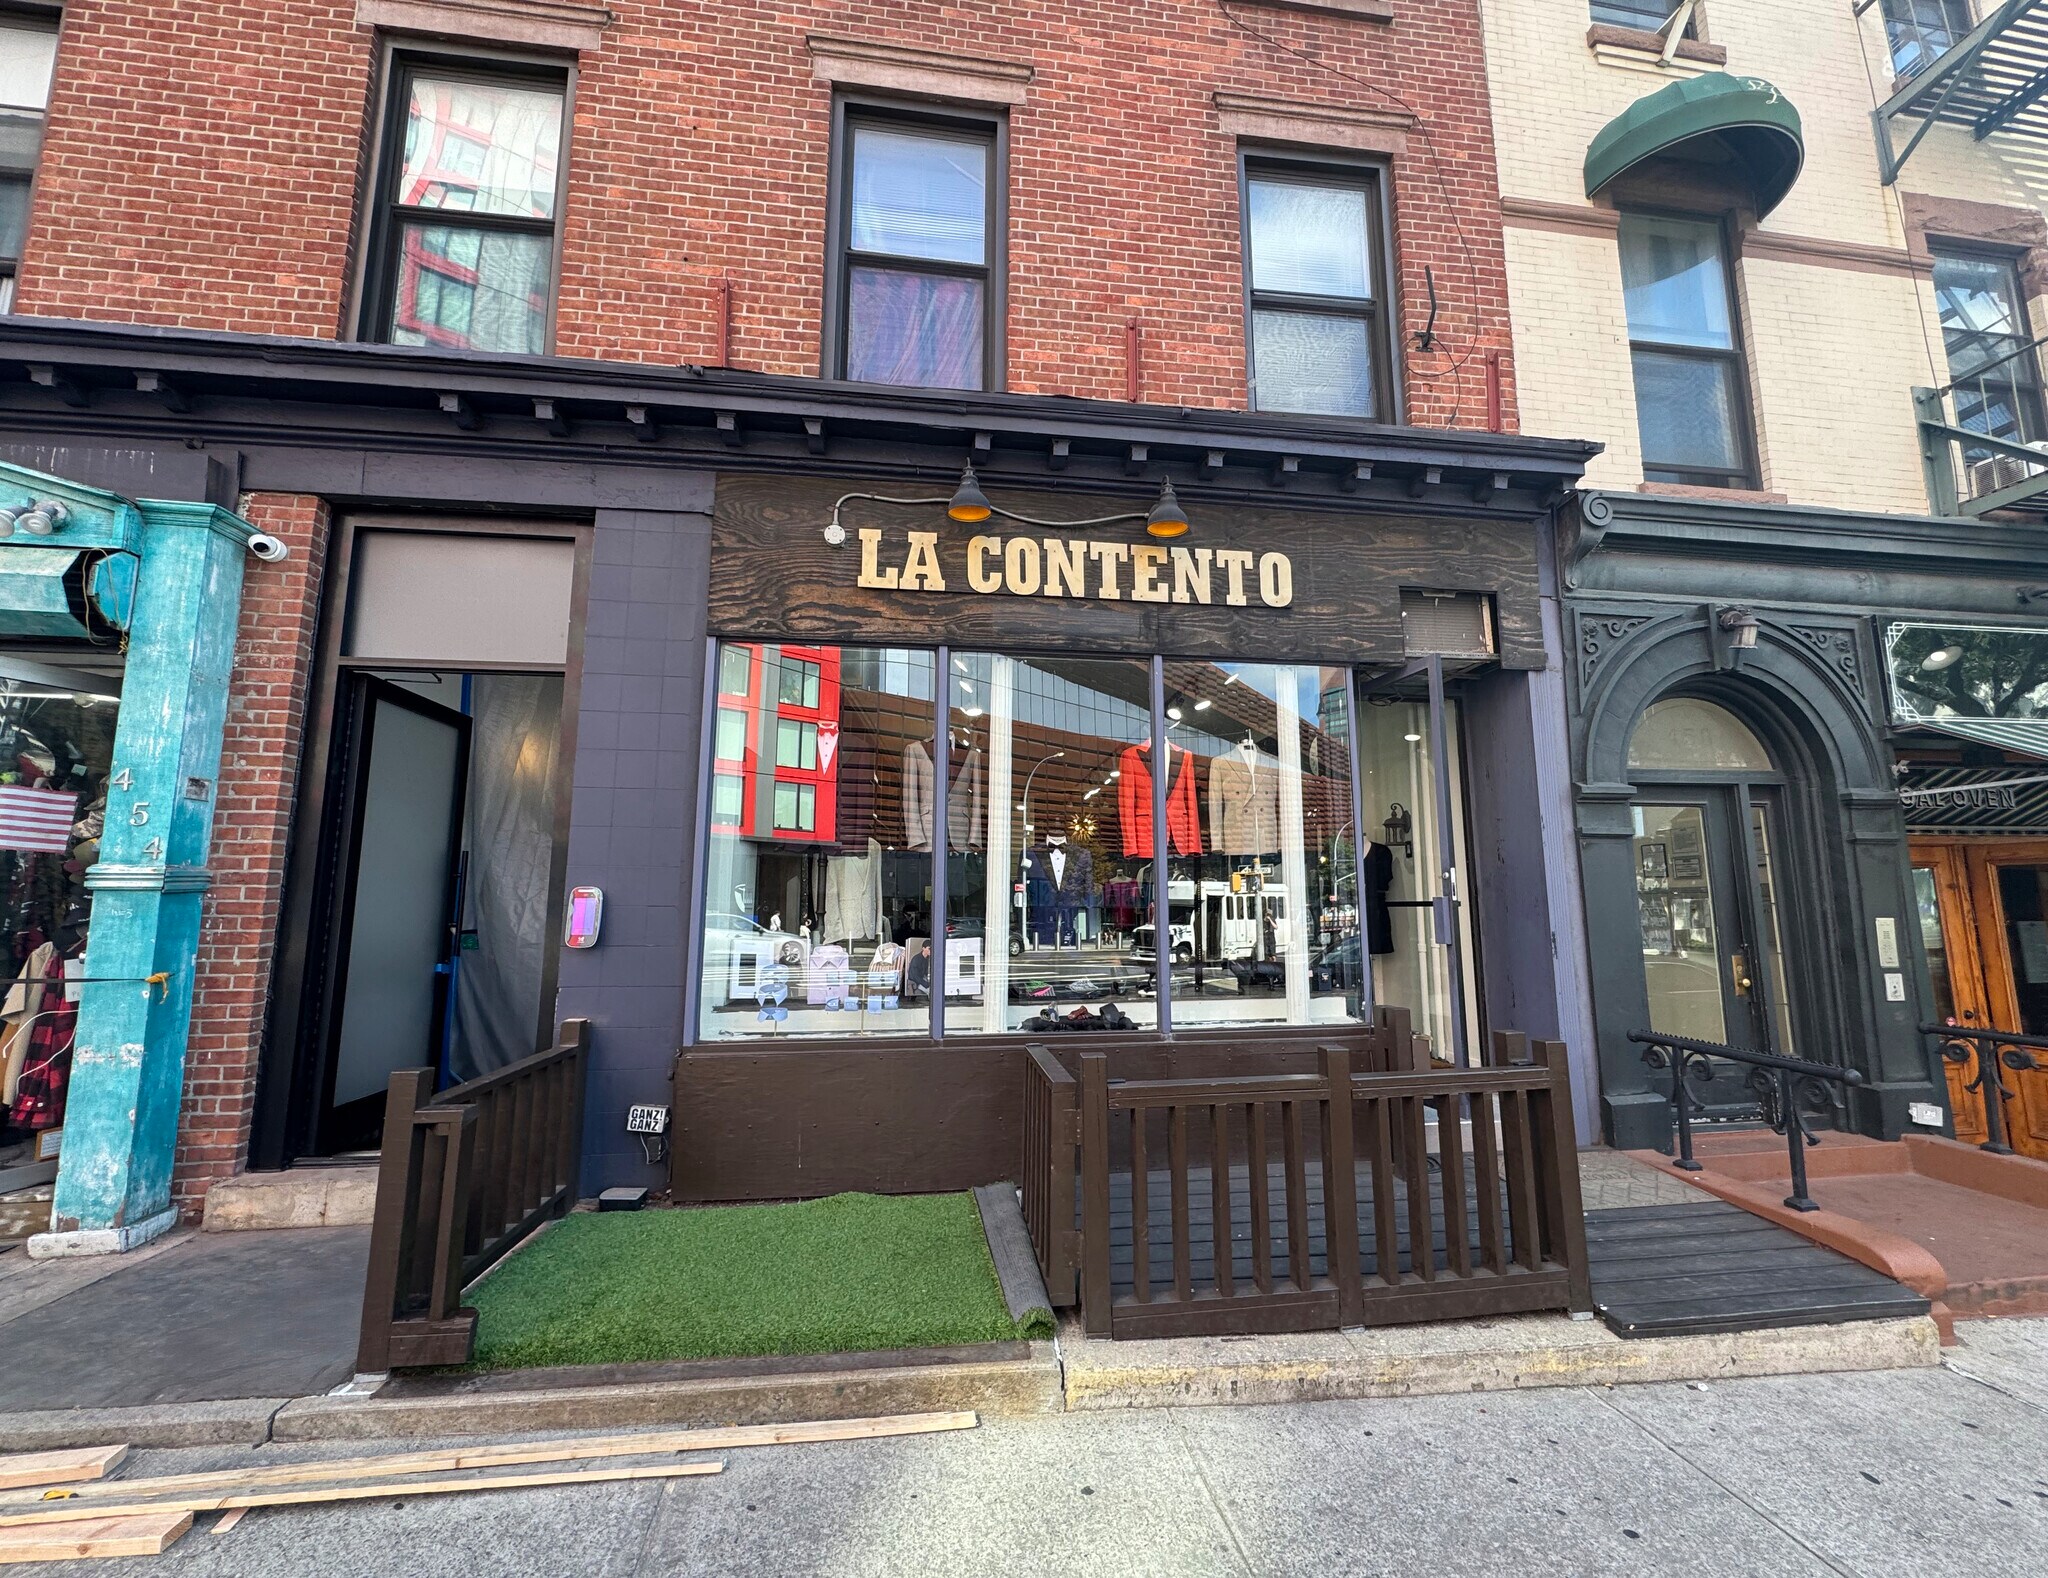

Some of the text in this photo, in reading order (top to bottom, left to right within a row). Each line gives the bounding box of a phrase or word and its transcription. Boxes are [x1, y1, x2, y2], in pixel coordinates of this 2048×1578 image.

[857, 528, 1293, 608] LA CONTENTO
[1950, 785, 2017, 810] OVEN
[631, 1108, 664, 1121] GANZ!
[629, 1118, 659, 1131] GANZ
